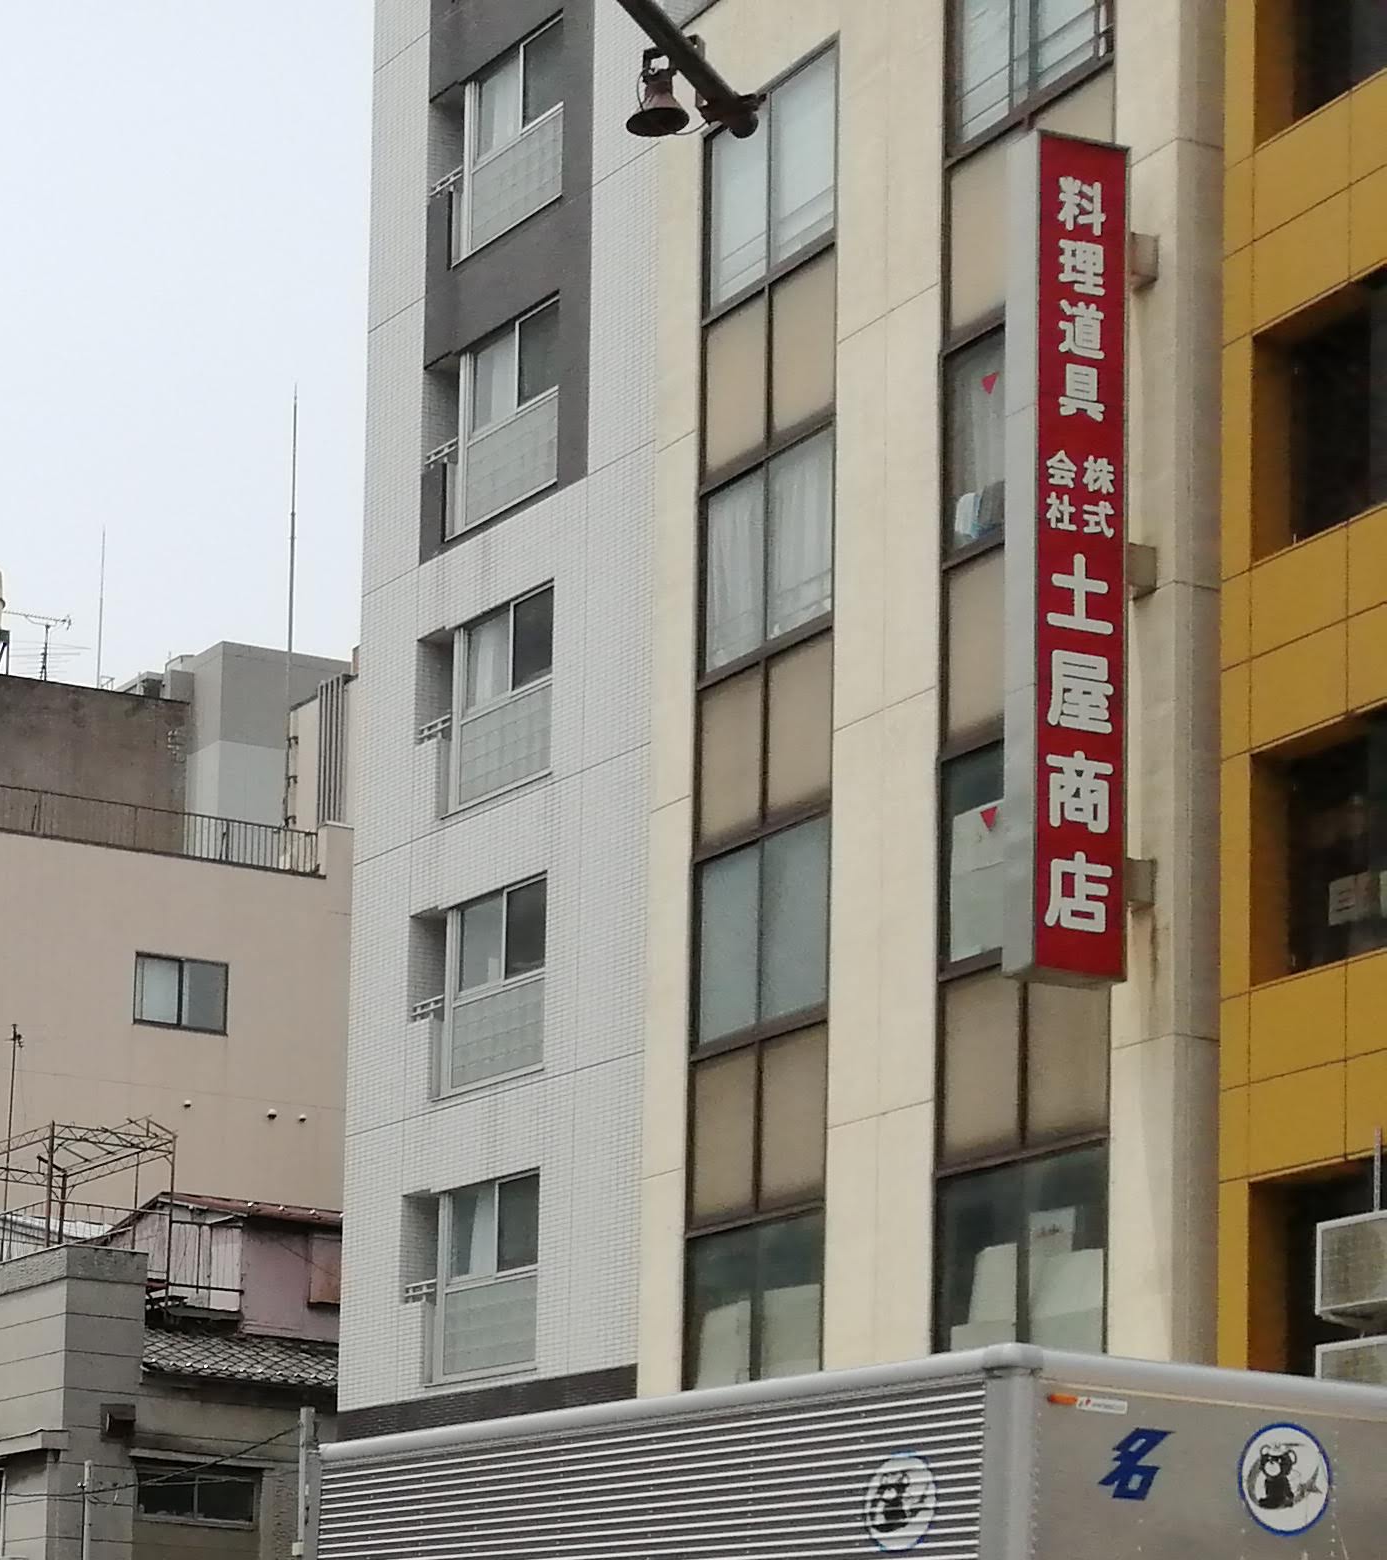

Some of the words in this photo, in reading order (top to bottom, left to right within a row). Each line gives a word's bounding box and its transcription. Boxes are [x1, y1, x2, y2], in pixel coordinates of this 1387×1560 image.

[1056, 176, 1107, 422] 料理道具
[1043, 552, 1115, 935] 土屋商店
